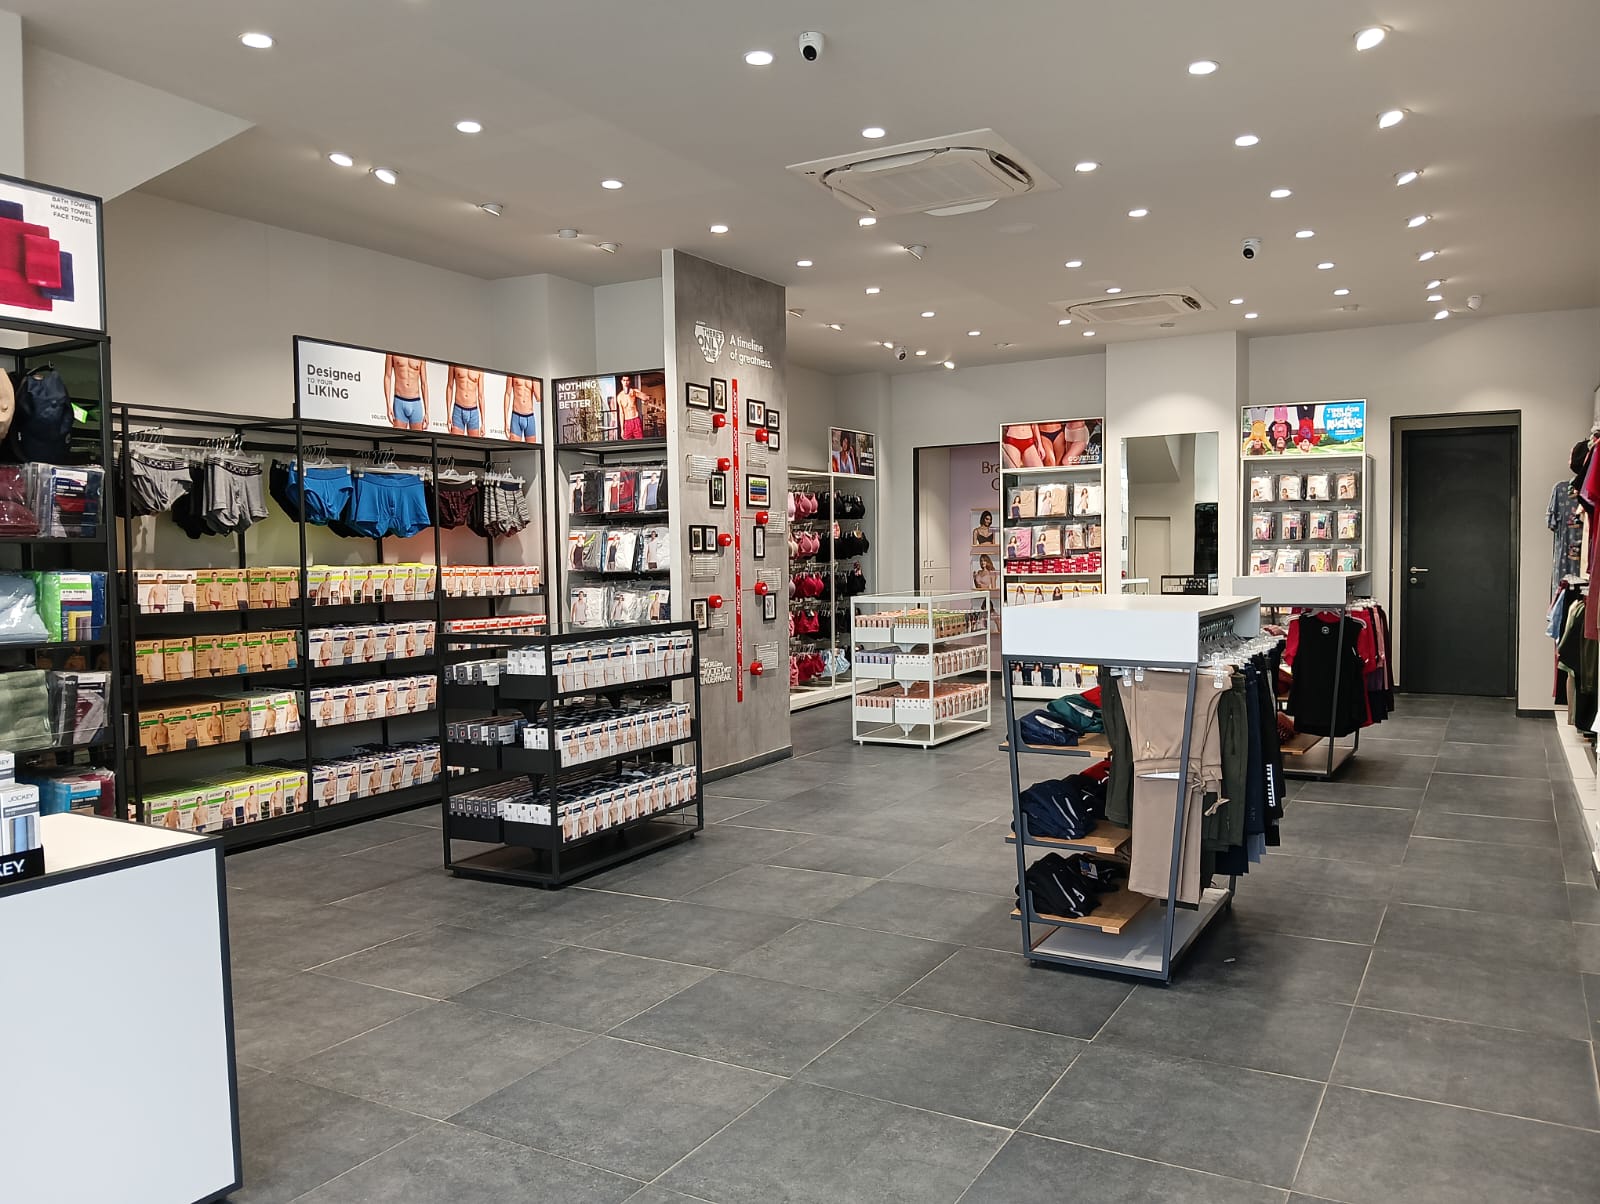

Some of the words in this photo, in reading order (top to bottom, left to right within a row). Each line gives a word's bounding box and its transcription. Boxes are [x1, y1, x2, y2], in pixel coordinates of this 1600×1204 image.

[51, 204, 69, 212] HAND
[71, 207, 93, 217] TOWEL
[71, 200, 92, 210] TOWEL
[53, 211, 69, 220] FACE
[71, 215, 93, 225] TOWEL
[729, 334, 736, 346] A
[737, 336, 765, 353] timeline
[730, 349, 738, 361] of
[307, 363, 361, 382] Designed
[307, 383, 349, 400] LIKING
[558, 380, 597, 391] NOTHING
[558, 391, 577, 401] FITS
[559, 400, 591, 410] BETTER
